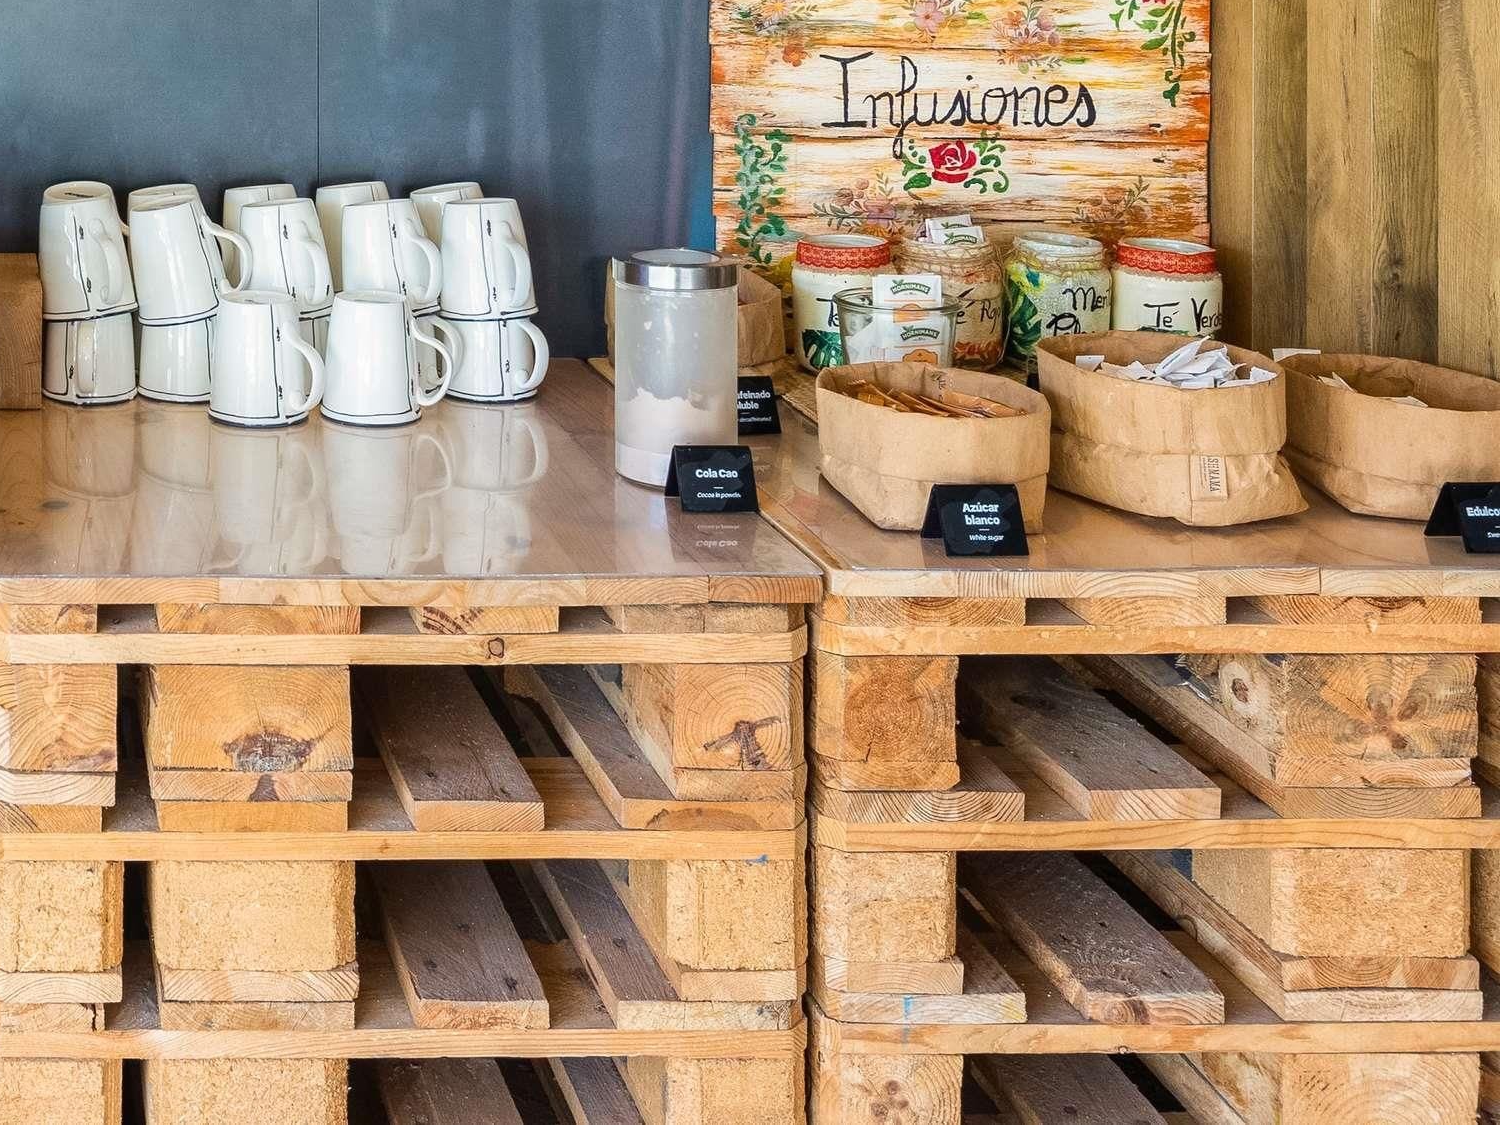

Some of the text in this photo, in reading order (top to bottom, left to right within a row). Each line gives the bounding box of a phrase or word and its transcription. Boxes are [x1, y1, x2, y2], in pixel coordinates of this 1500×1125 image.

[819, 50, 1097, 160] Infusiones
[1143, 301, 1180, 328] Té
[695, 468, 739, 478] Cola Cao
[962, 502, 1000, 513] Azúcar
[1466, 506, 1500, 517] Edulco
[964, 514, 1000, 526] blanco
